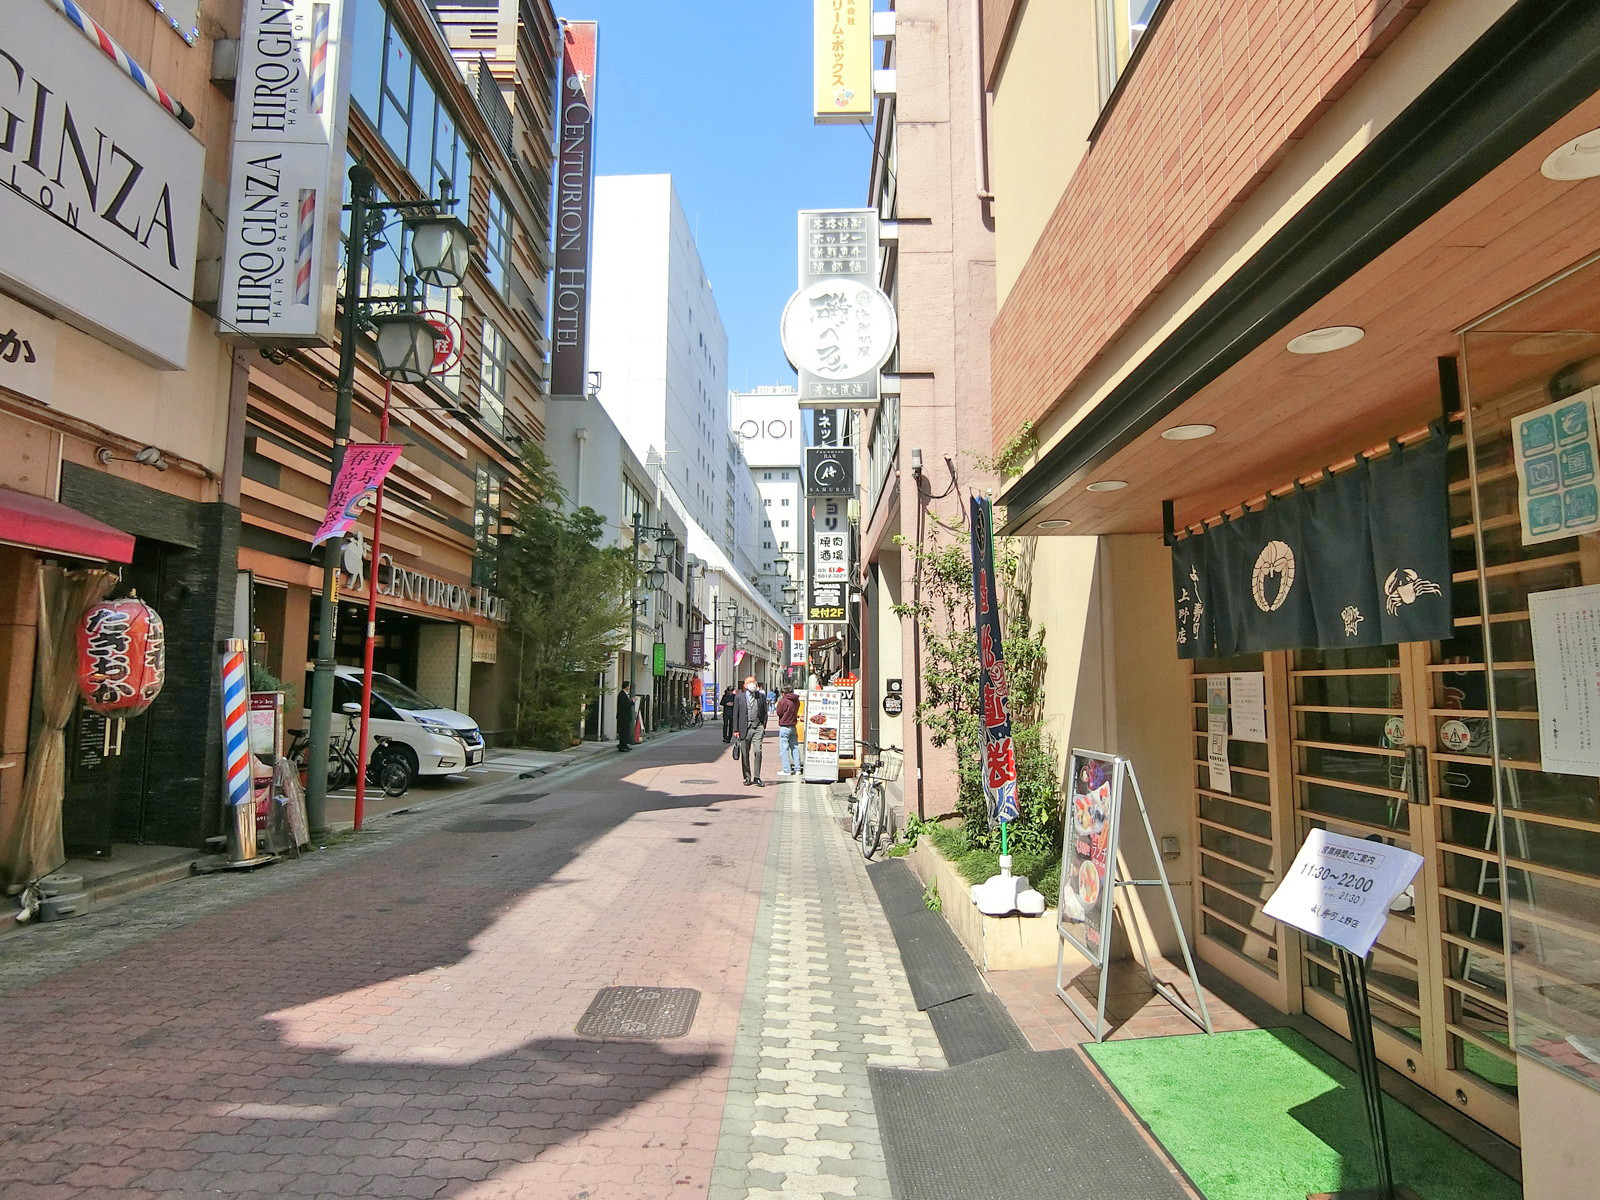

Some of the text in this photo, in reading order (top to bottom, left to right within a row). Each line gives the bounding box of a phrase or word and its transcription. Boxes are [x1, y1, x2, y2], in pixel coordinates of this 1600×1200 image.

[251, 0, 300, 132] HIRO GIN
[287, 14, 304, 125] HAIR SALON
[235, 153, 285, 326] HIRO GINZA
[555, 103, 592, 353] CENTURION HOTEL
[812, 232, 863, 244] ホッピー
[272, 200, 290, 319] HAIR SALON
[375, 552, 472, 613] CENTURION
[810, 607, 845, 619] 受付2F
[1176, 588, 1191, 645] 上野店
[1320, 845, 1376, 865] 営業時間のご案内
[1337, 915, 1360, 929] 上野店
